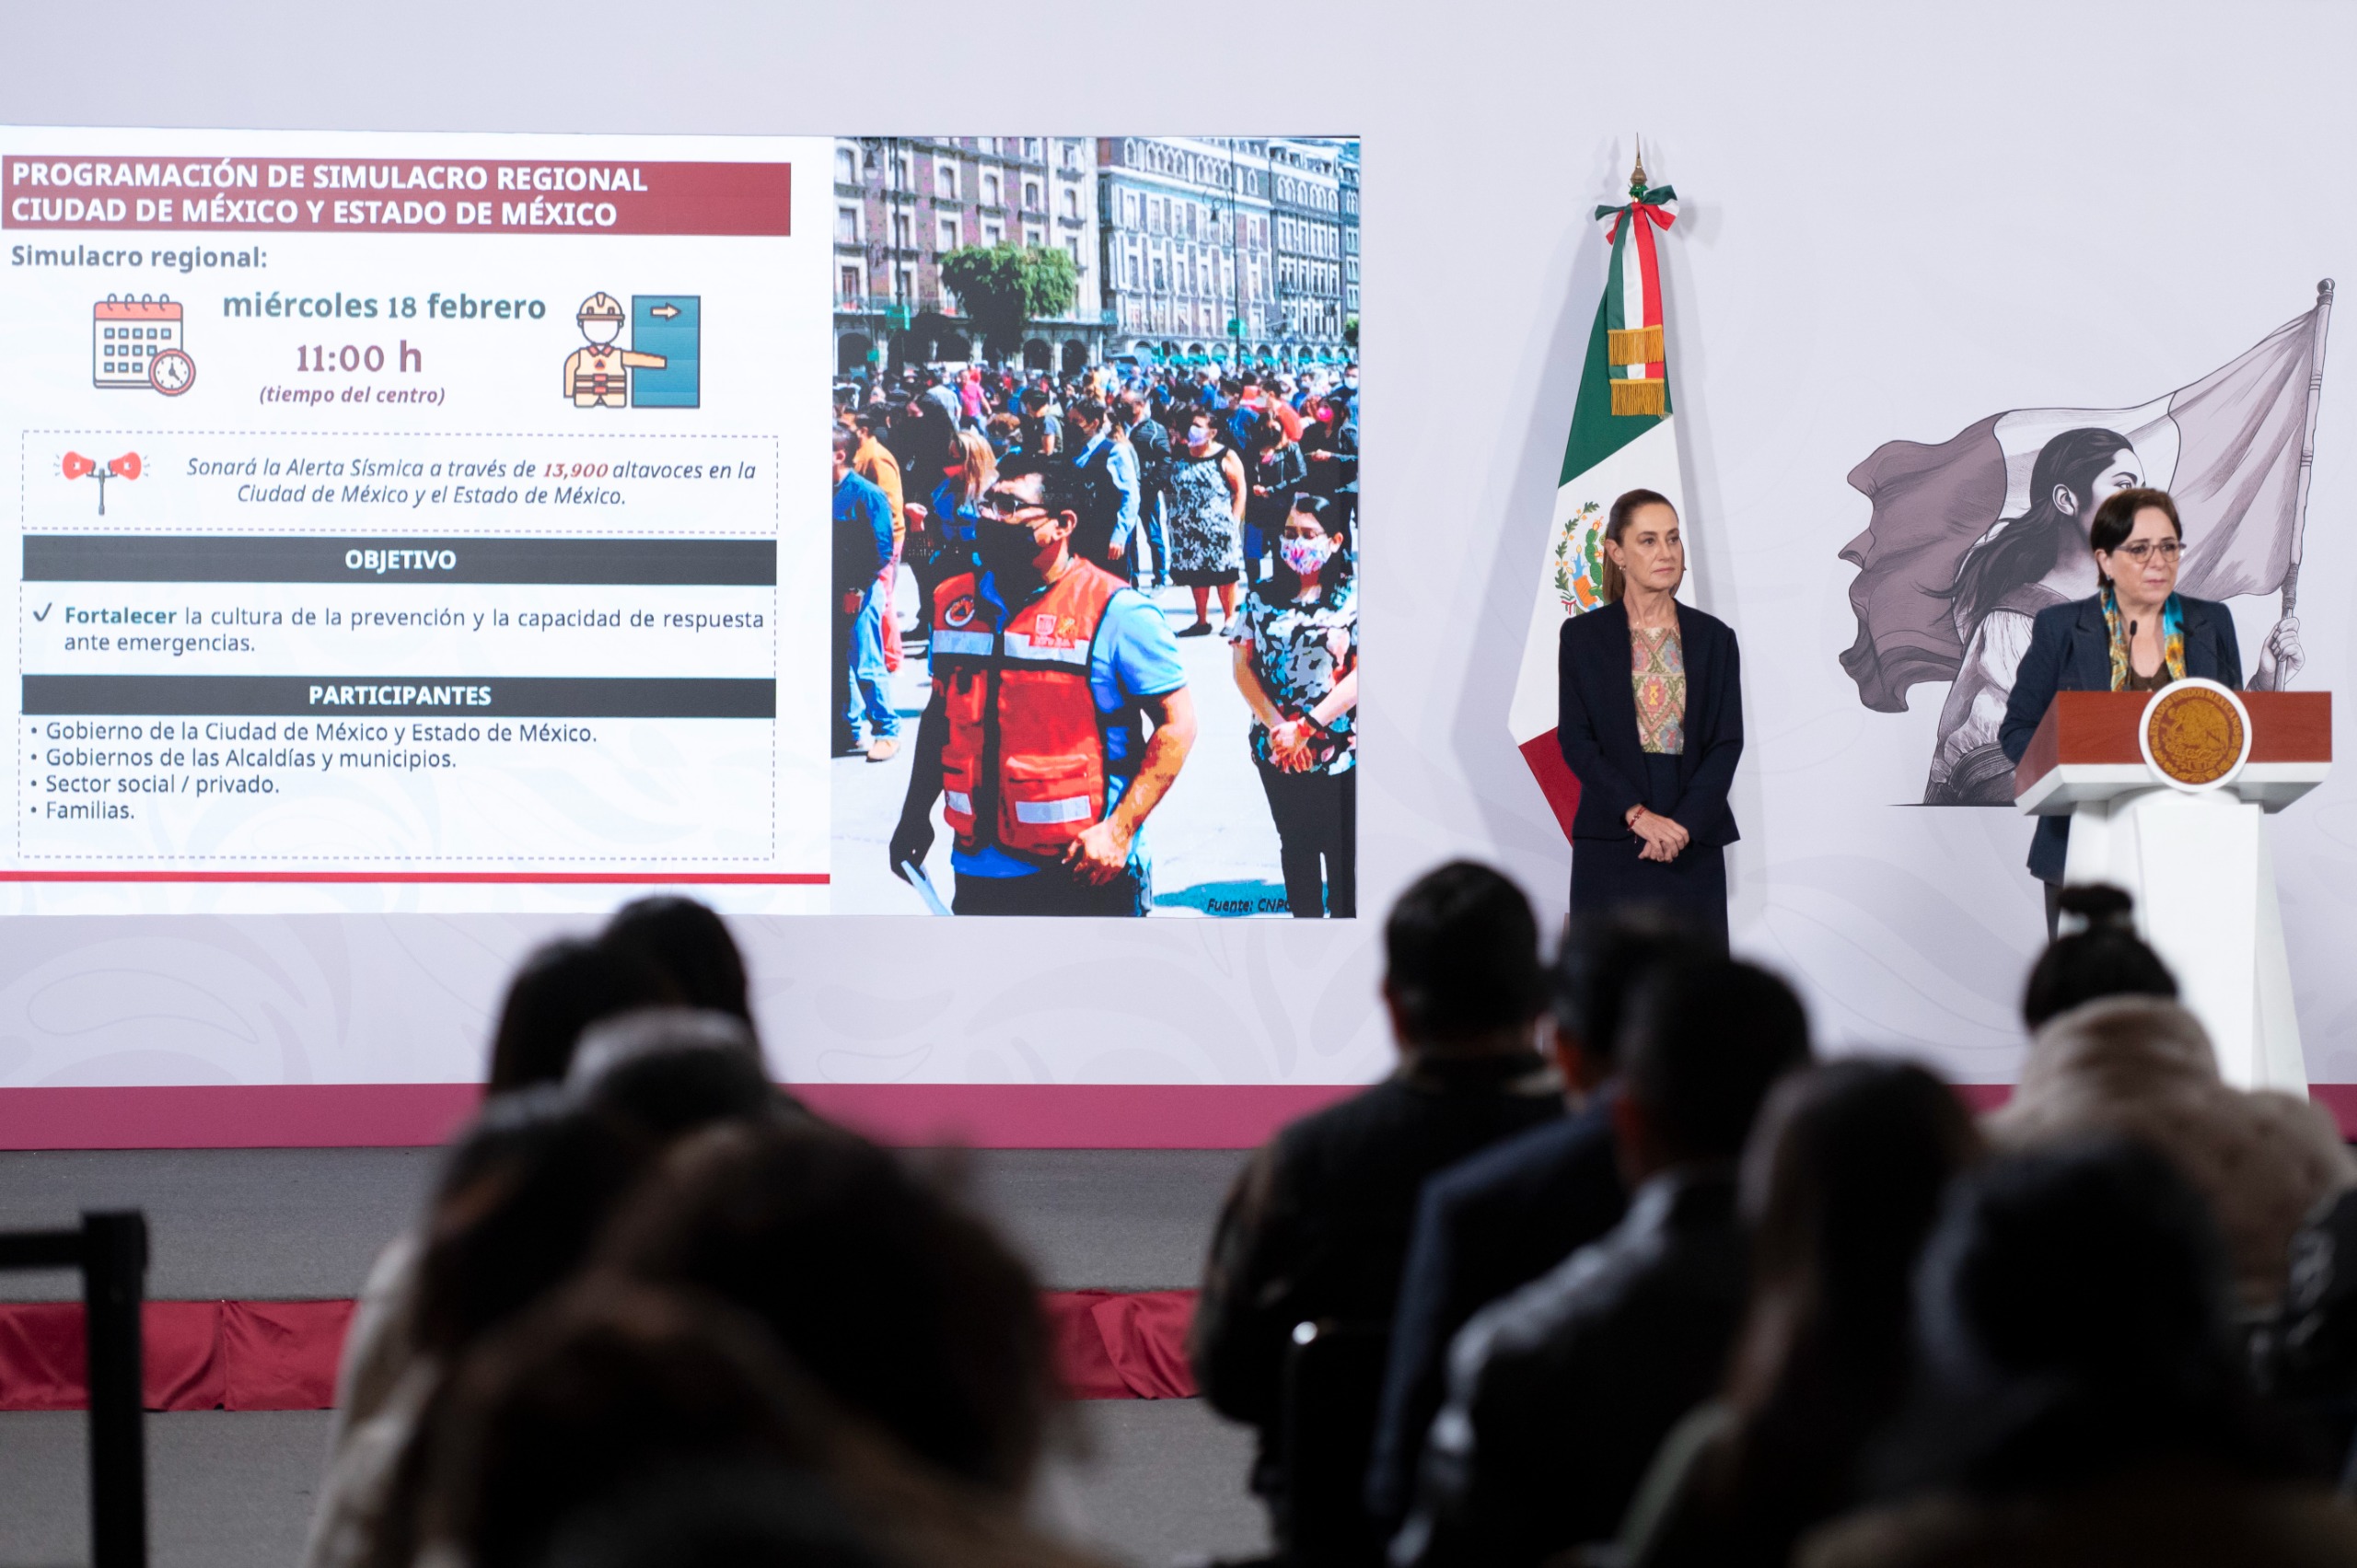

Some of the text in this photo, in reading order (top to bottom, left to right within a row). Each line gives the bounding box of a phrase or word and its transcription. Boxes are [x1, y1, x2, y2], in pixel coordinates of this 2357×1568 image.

[11, 158, 648, 192] PROGRAMACIÓN DE SIMULACRO REGIONAL
[11, 193, 617, 226] CIUDAD DE MÉXICO Y ESTADO DE MÉXICO
[11, 244, 267, 273] Simulacro regional:
[224, 291, 546, 319] miércoles 18 febrero
[296, 339, 422, 373] 11:00 h
[259, 385, 446, 407] (tiempo del centro)
[187, 457, 756, 481] Sonará la Alerta Sísmica a través de 13,900 altavoces en la
[238, 483, 625, 509] Ciudad de México y el Estado de México.
[344, 550, 457, 573] OBJETIVO
[65, 607, 763, 633] Fortalecer la cultura de la prevención y la capacidad de respuesta
[64, 634, 255, 656] ante emergencias.
[309, 685, 492, 706] PARTICIPANTES
[2150, 689, 2242, 736] ESTADOS UNIDOS MEXICANOS
[46, 720, 597, 746] Gobierno de la Ciudad de México y Estado de México.
[46, 747, 457, 772] Gobiernos de las Alcaldías y municipios.
[46, 773, 279, 797] Sector social / privado.
[46, 800, 134, 819] Familias.
[1207, 898, 1253, 912] Fuente:
